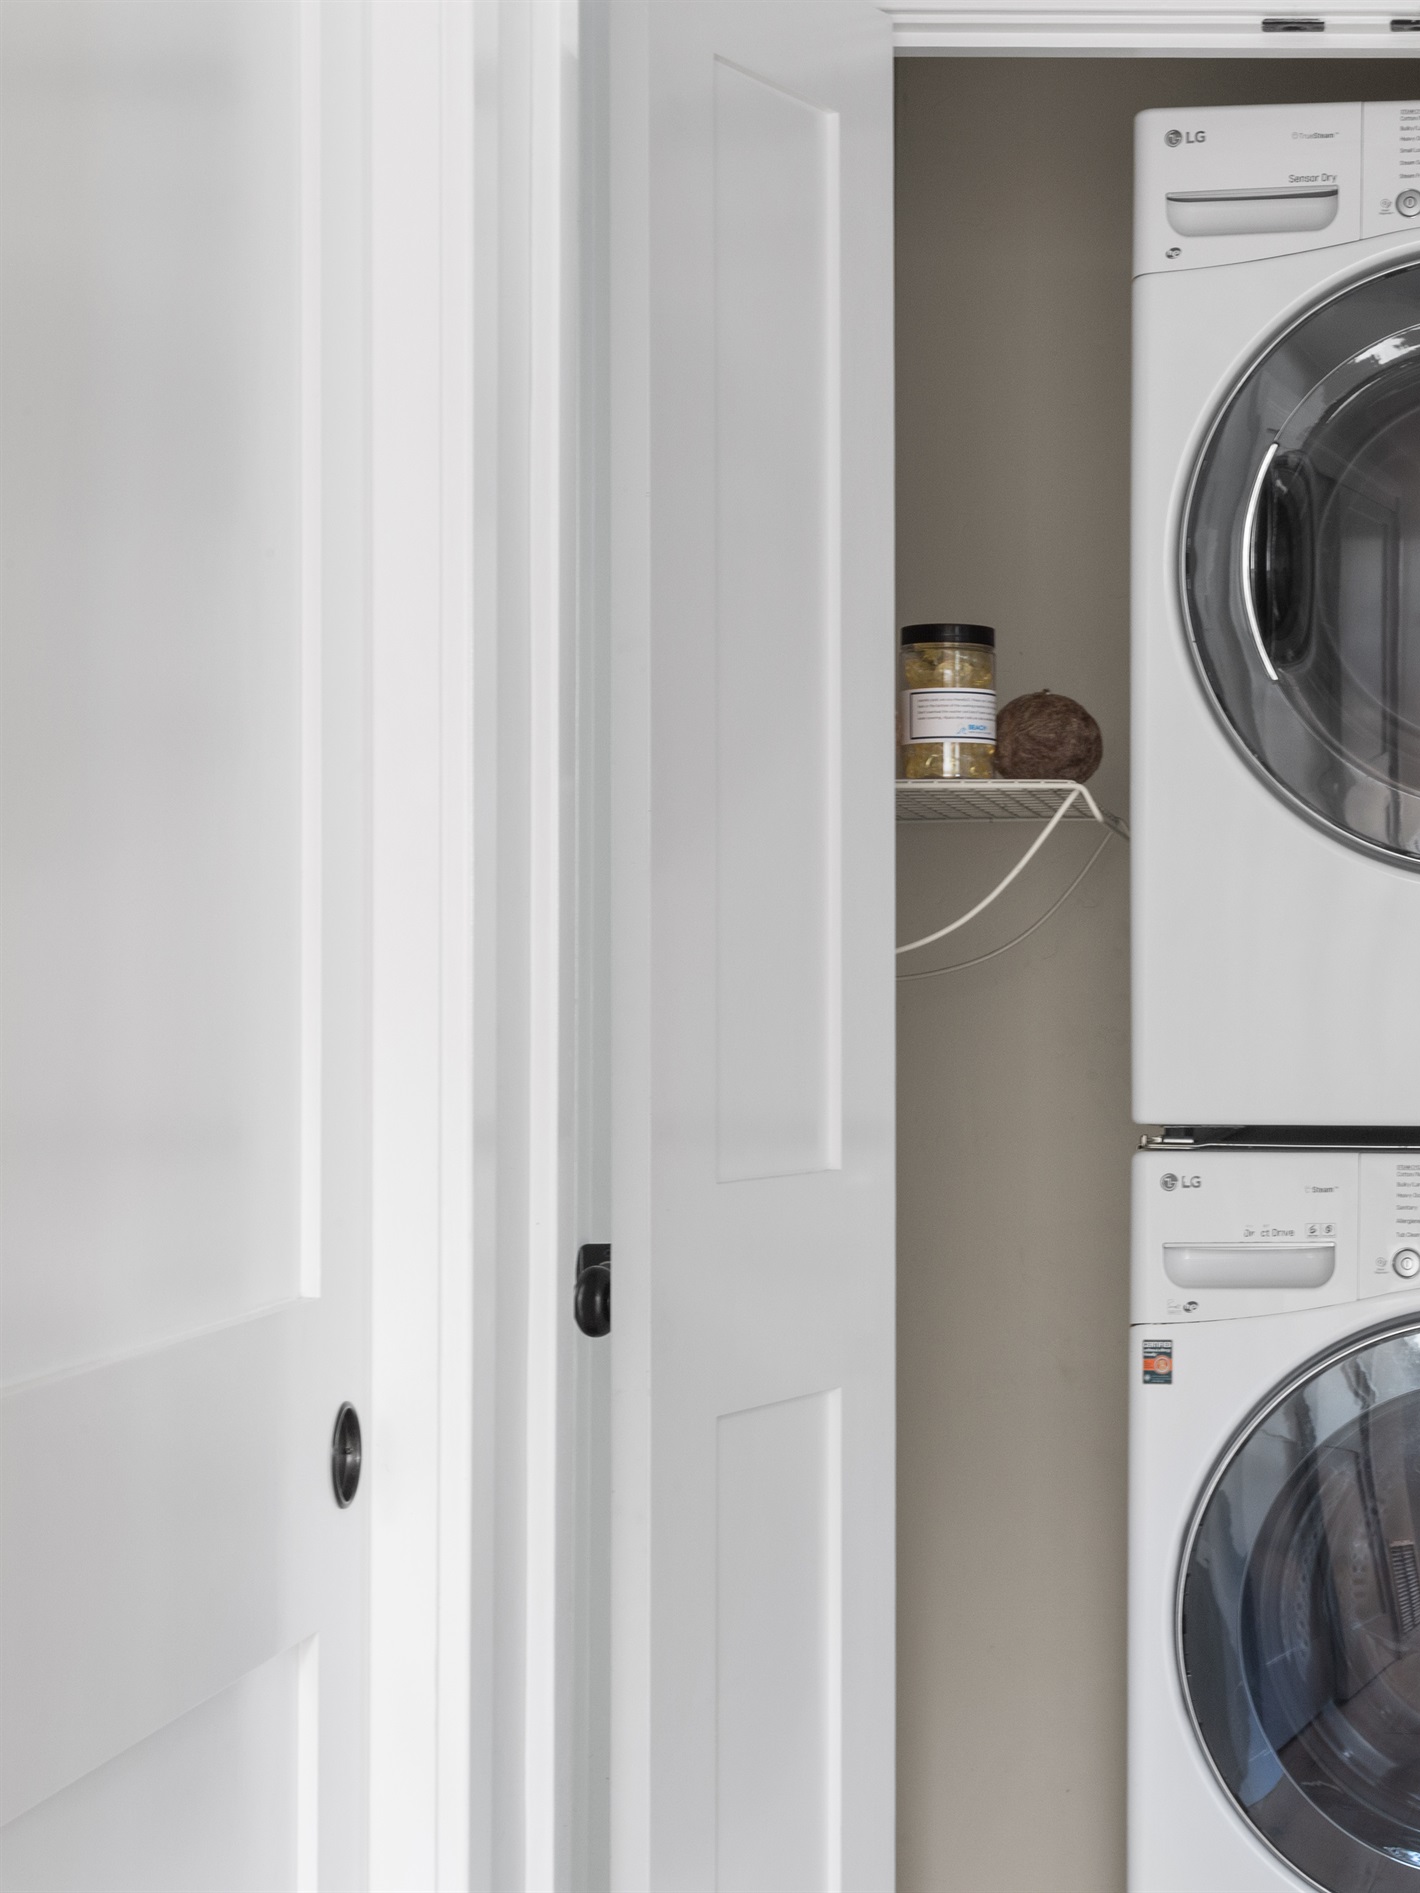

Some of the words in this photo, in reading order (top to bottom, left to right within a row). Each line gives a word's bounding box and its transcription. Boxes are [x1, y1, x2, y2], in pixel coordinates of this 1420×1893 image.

[1186, 131, 1206, 143] LG
[1288, 174, 1320, 183] Sensor
[1321, 173, 1338, 183] Dry
[1181, 1175, 1201, 1189] LG
[1271, 1228, 1295, 1237] Drive
